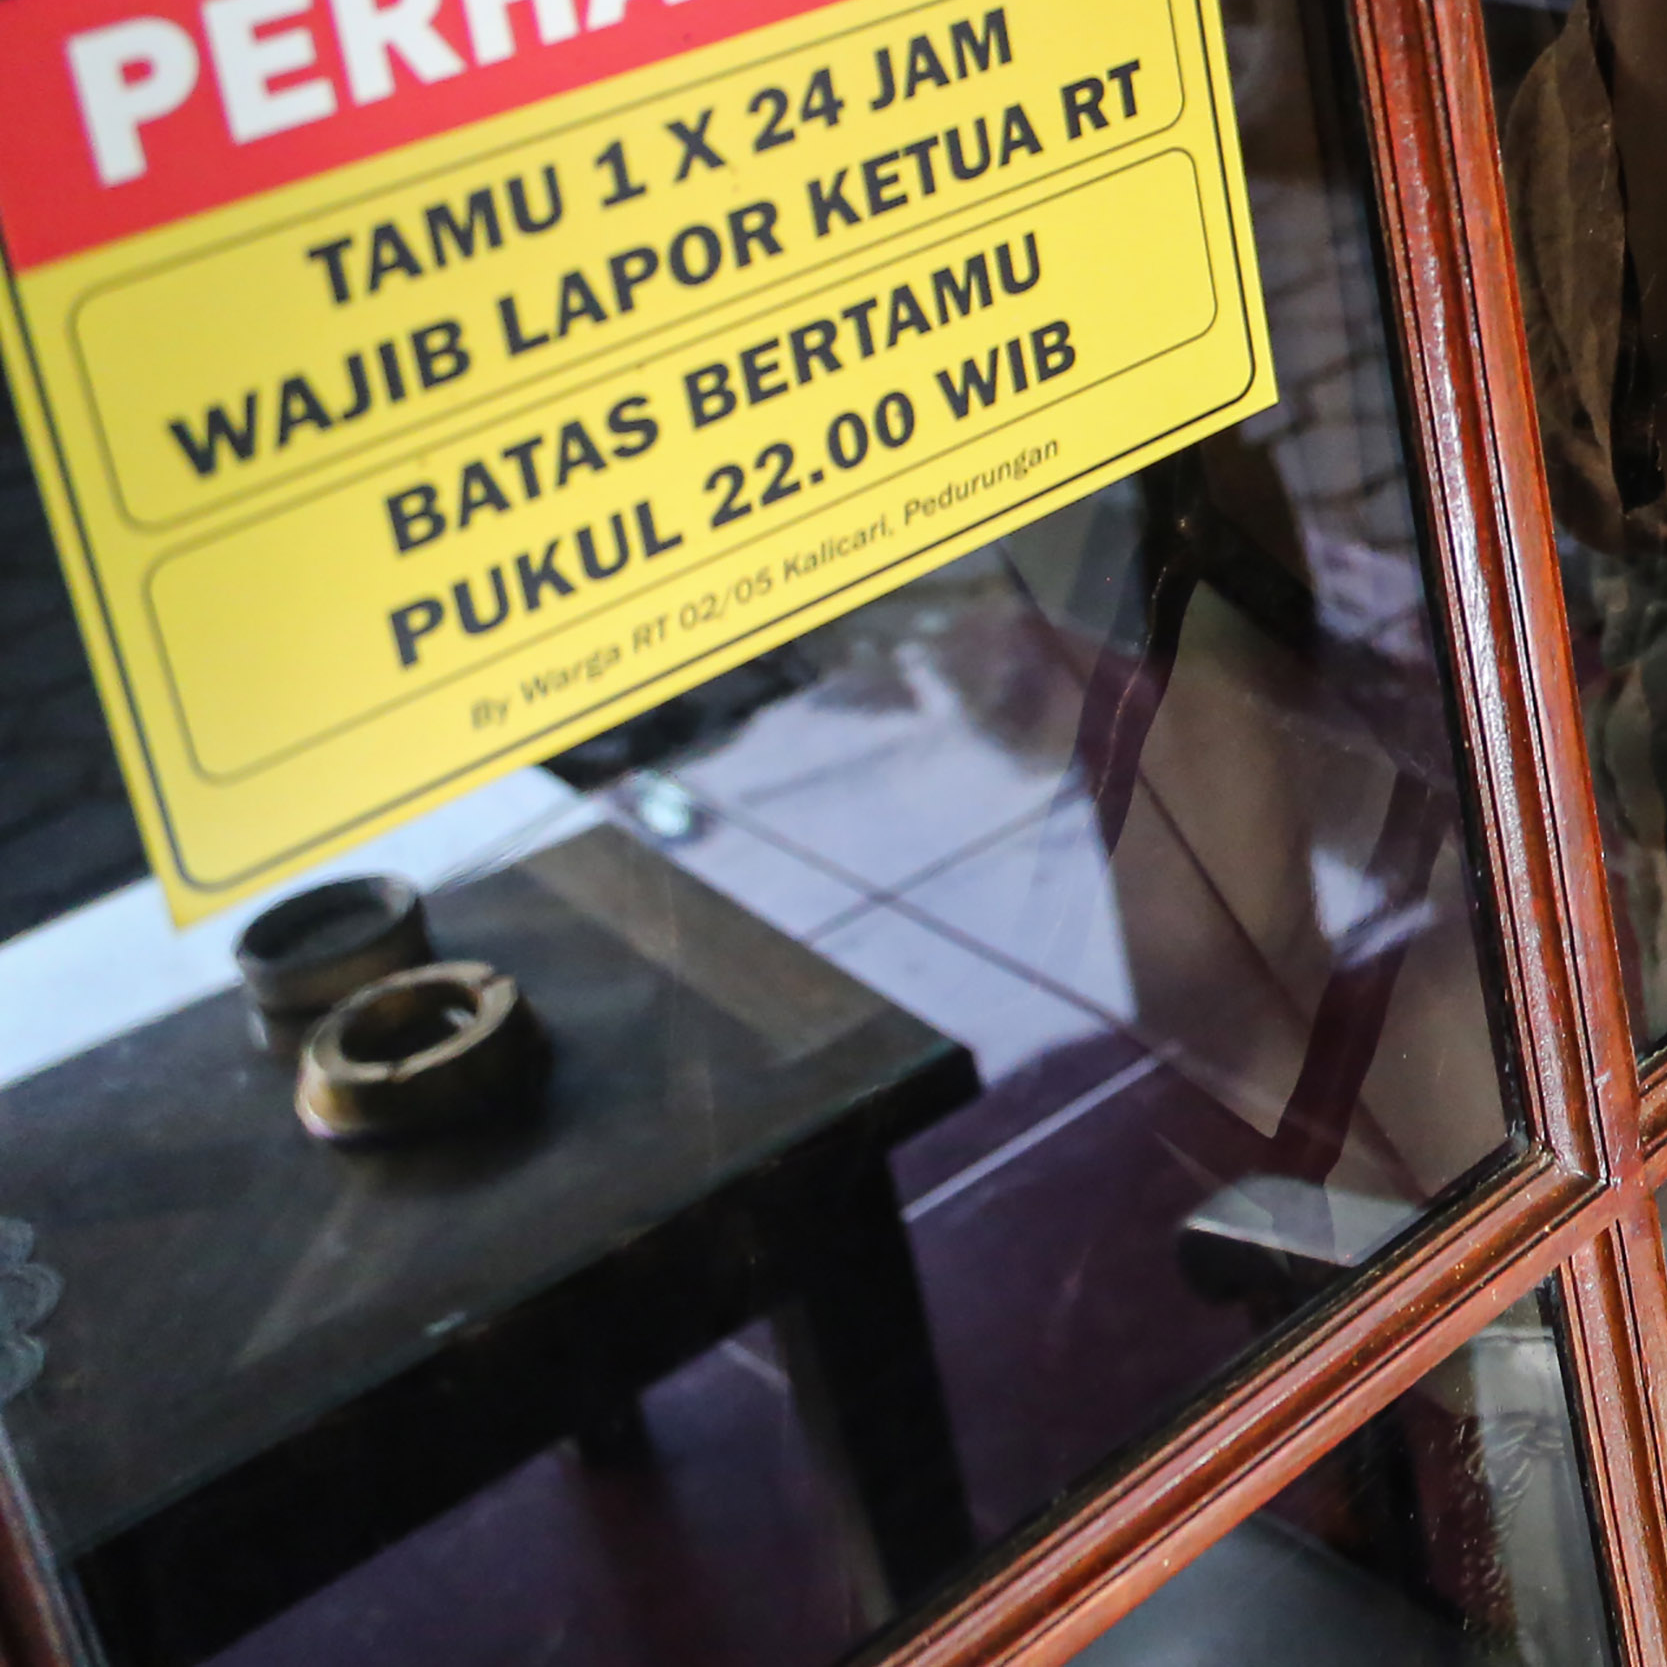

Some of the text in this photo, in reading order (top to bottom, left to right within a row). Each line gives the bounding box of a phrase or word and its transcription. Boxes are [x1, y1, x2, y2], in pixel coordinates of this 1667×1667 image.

[168, 60, 1149, 480] WAJIB LAPOR KETUA RT
[307, 5, 1017, 308] TAMU 1 X 24 JAM
[383, 231, 1046, 558] BATAS BERTAMU
[387, 319, 1079, 672] PUKUL 22.00 WIB
[468, 437, 1060, 732] By Warga RT 02/05 Kalicari, Pedurungan
